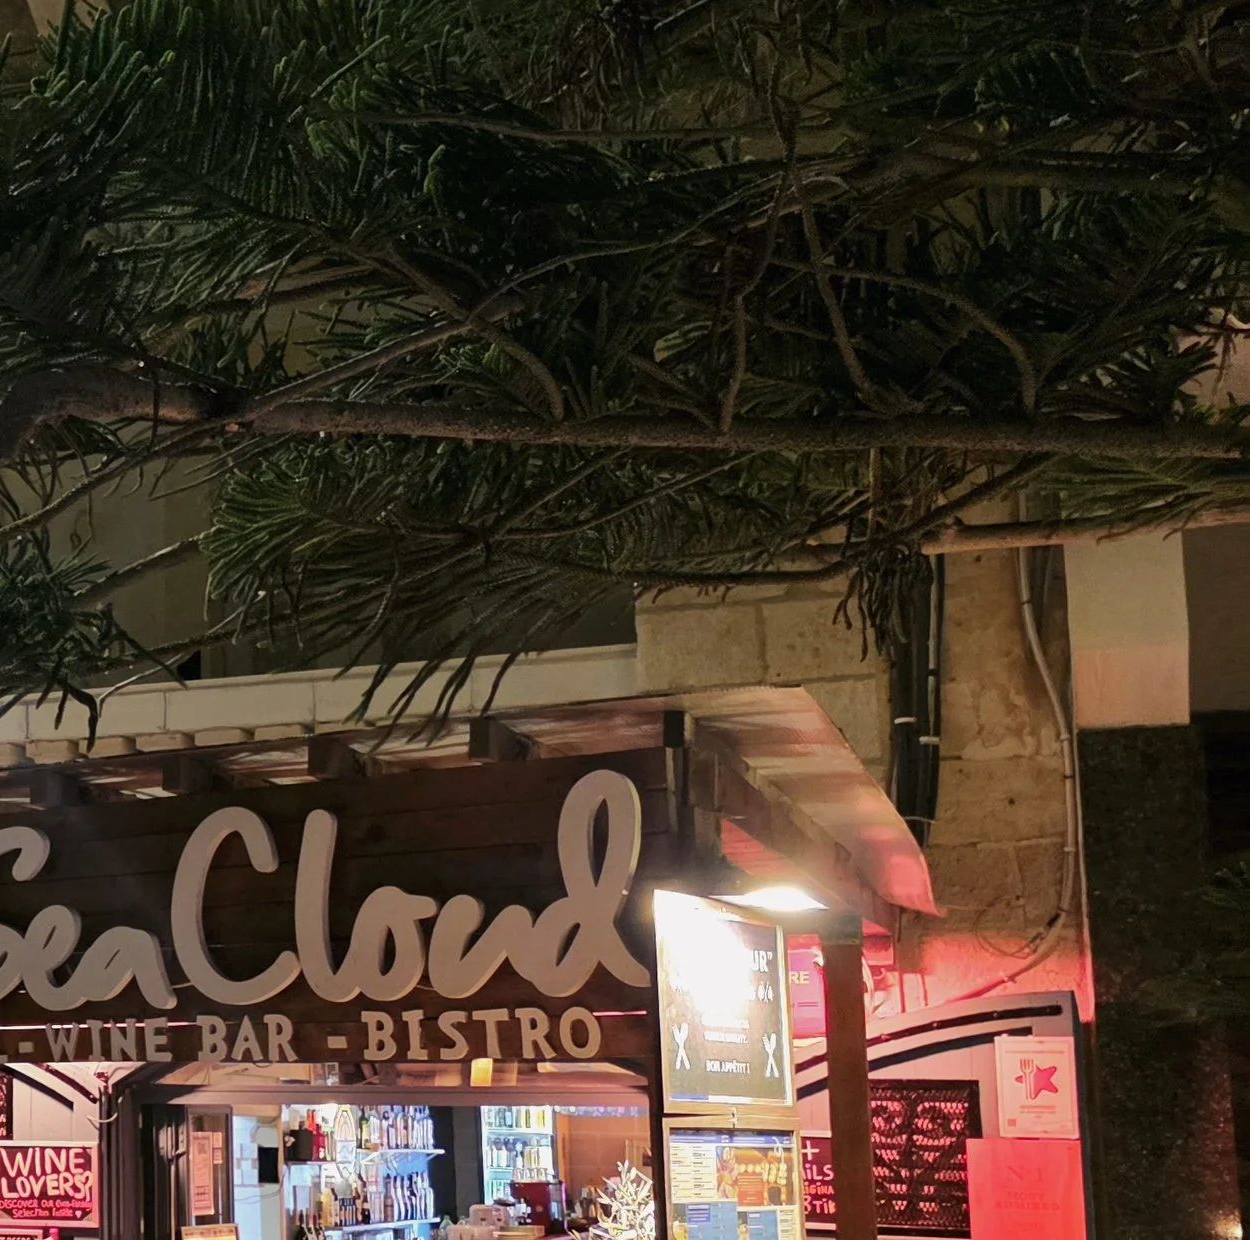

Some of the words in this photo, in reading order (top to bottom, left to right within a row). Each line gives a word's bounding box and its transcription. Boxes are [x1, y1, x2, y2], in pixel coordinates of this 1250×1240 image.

[171, 769, 652, 1006] Cloud
[46, 1016, 173, 1063] WINE
[196, 1014, 298, 1063] BAR
[361, 1006, 602, 1061] BISTRO
[0, 1146, 85, 1178] WINE
